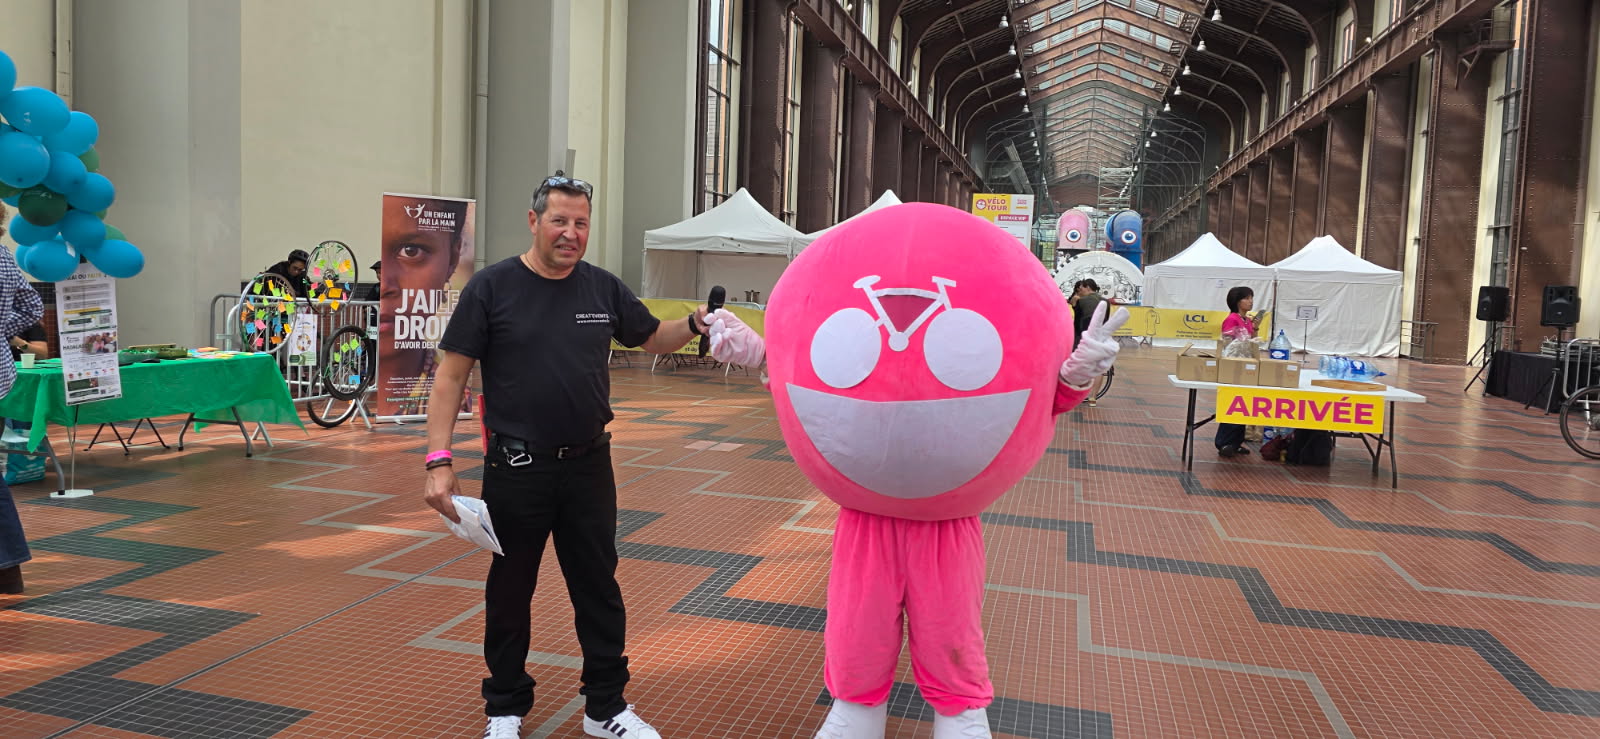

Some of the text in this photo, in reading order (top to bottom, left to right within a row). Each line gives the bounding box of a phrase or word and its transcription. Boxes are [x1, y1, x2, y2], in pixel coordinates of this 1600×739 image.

[394, 288, 460, 313] J'AI LE
[394, 315, 452, 340] DROI
[1185, 314, 1208, 323] LCL
[394, 341, 420, 349] D'AVOIR
[422, 341, 435, 349] DES
[1226, 396, 1374, 424] ARRIVÉE
